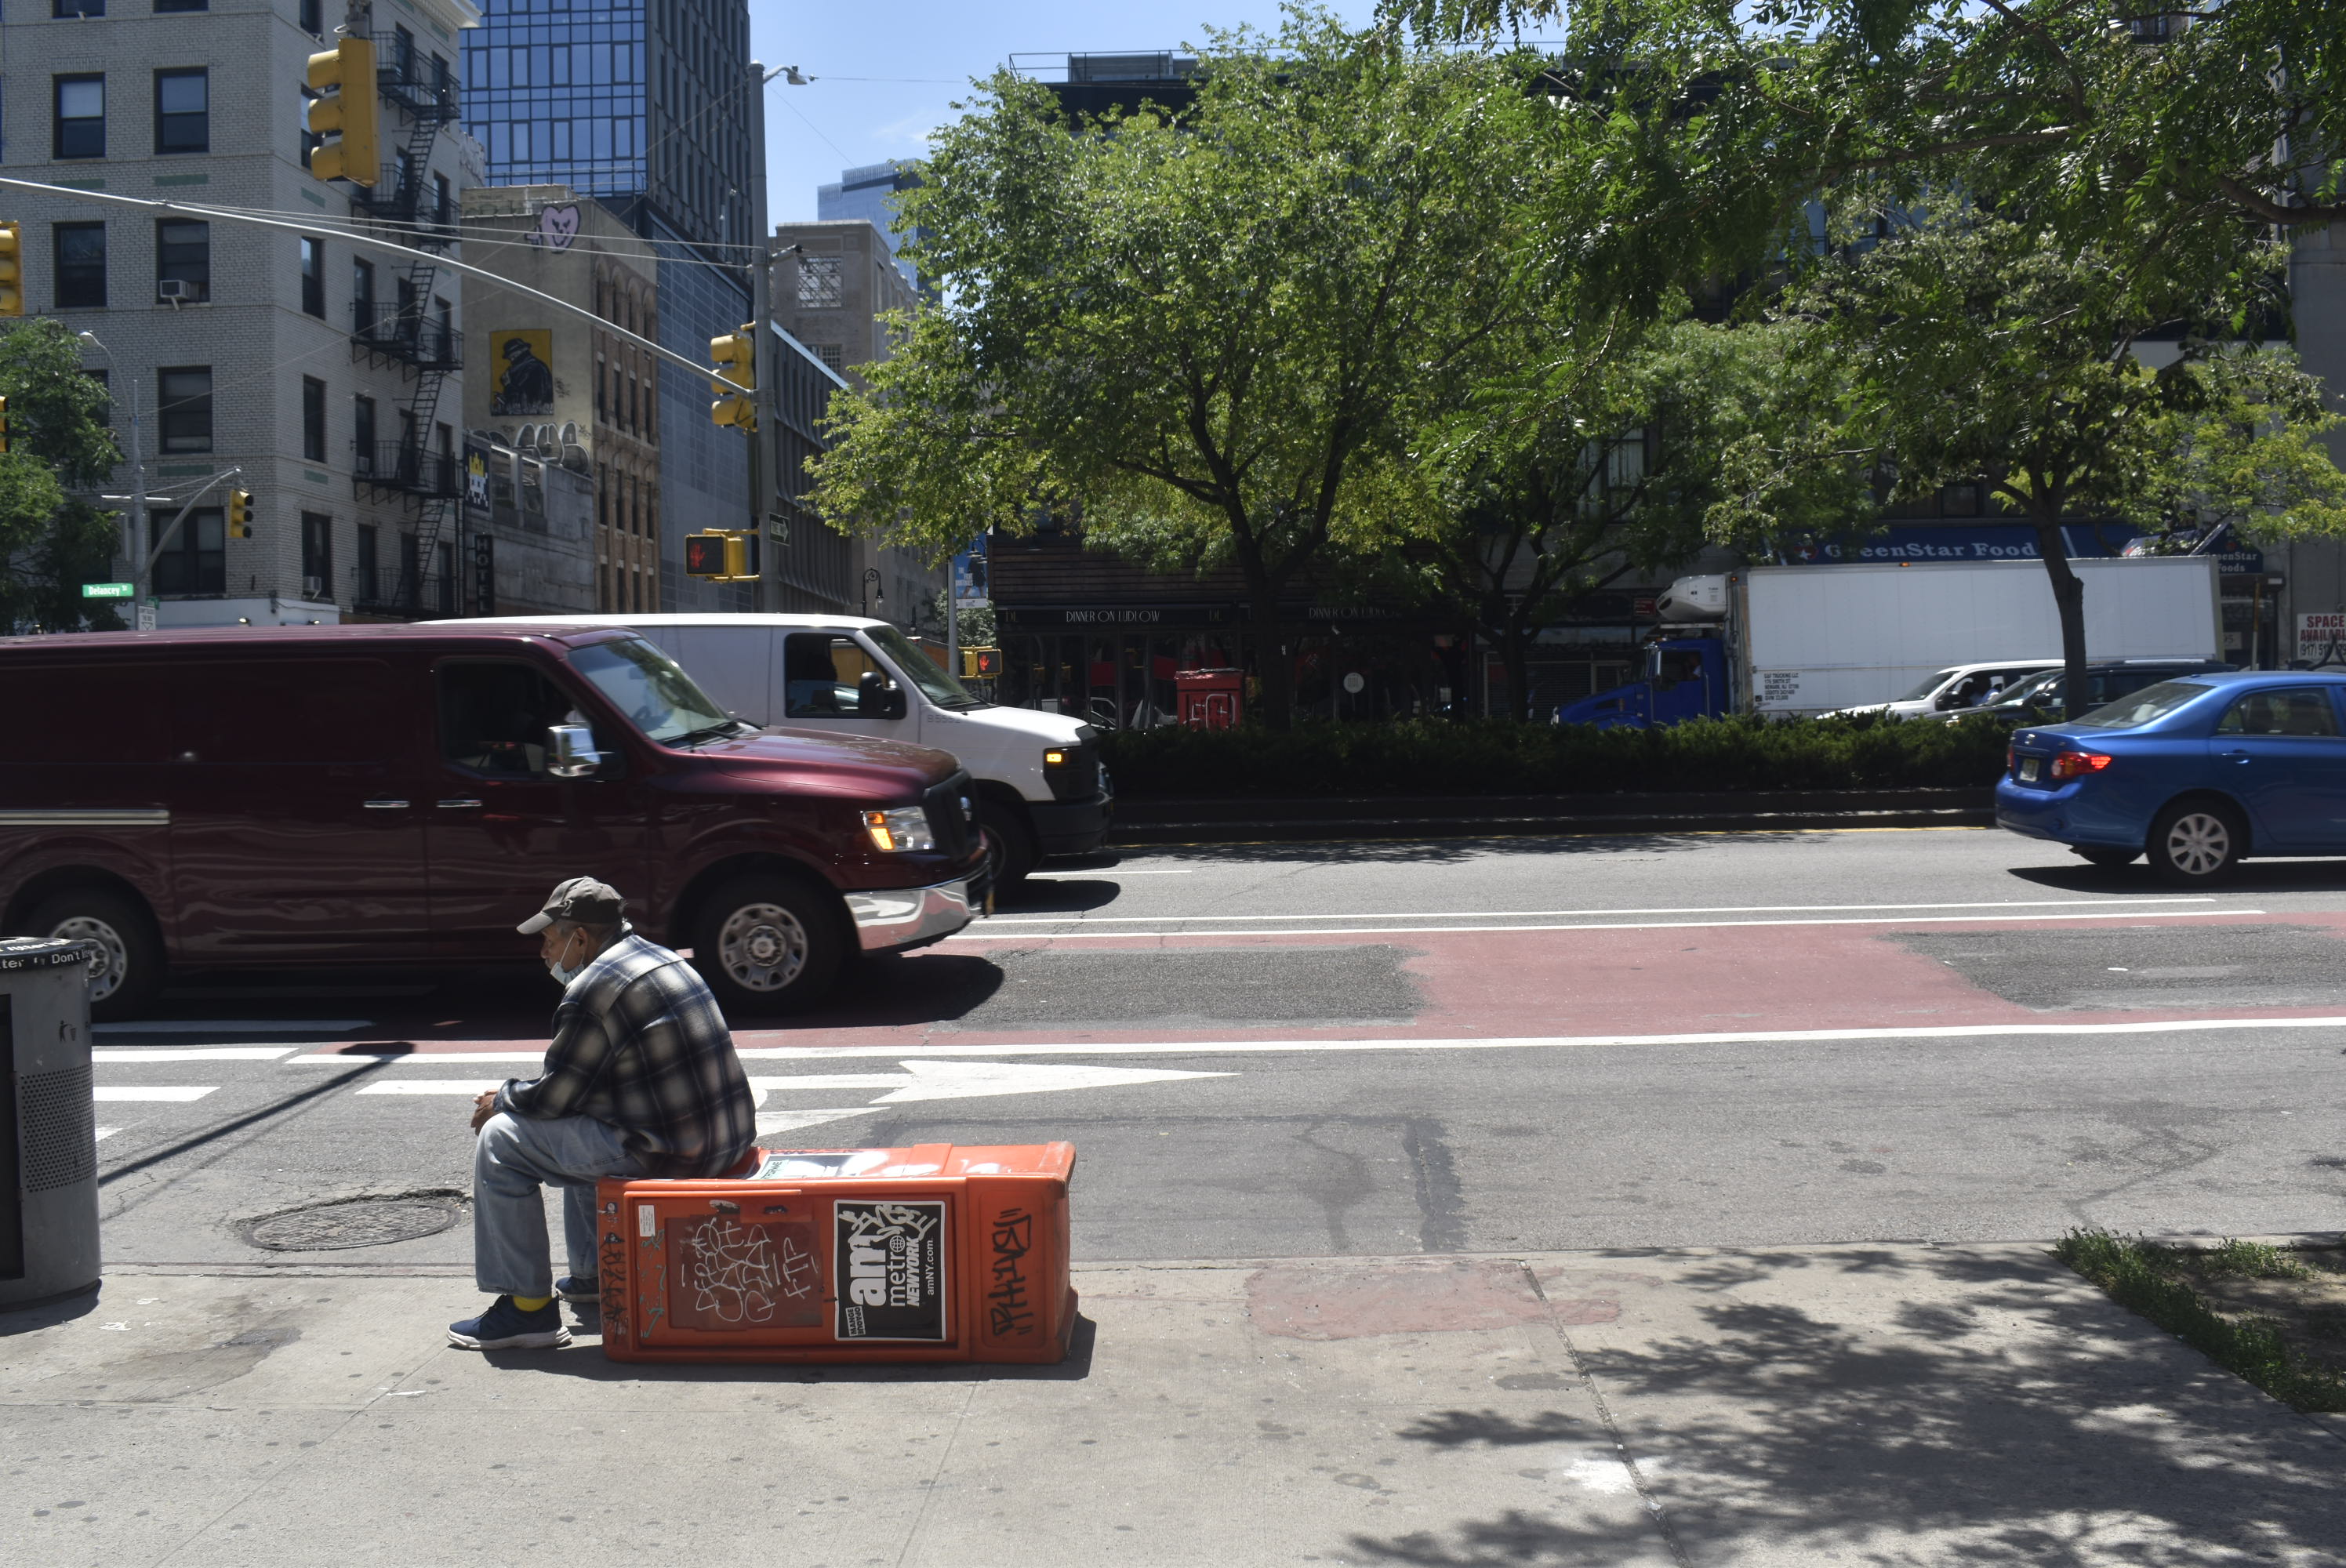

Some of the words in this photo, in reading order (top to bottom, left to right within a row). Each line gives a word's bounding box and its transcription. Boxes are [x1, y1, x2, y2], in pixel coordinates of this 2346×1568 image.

[1825, 543, 1965, 557] GeenStar
[478, 539, 489, 612] HOTEL
[88, 586, 120, 597] Delancey
[1066, 611, 1095, 622] DINNER
[1098, 611, 1114, 622] ON
[1117, 611, 1160, 622] LUDLOW
[1309, 607, 1338, 620] DINNER
[2307, 615, 2345, 628] SPACE
[561, 898, 575, 916] 2
[51, 949, 80, 964] Don't
[847, 1308, 857, 1334] MANGE
[855, 1307, 864, 1335] OPAQUE
